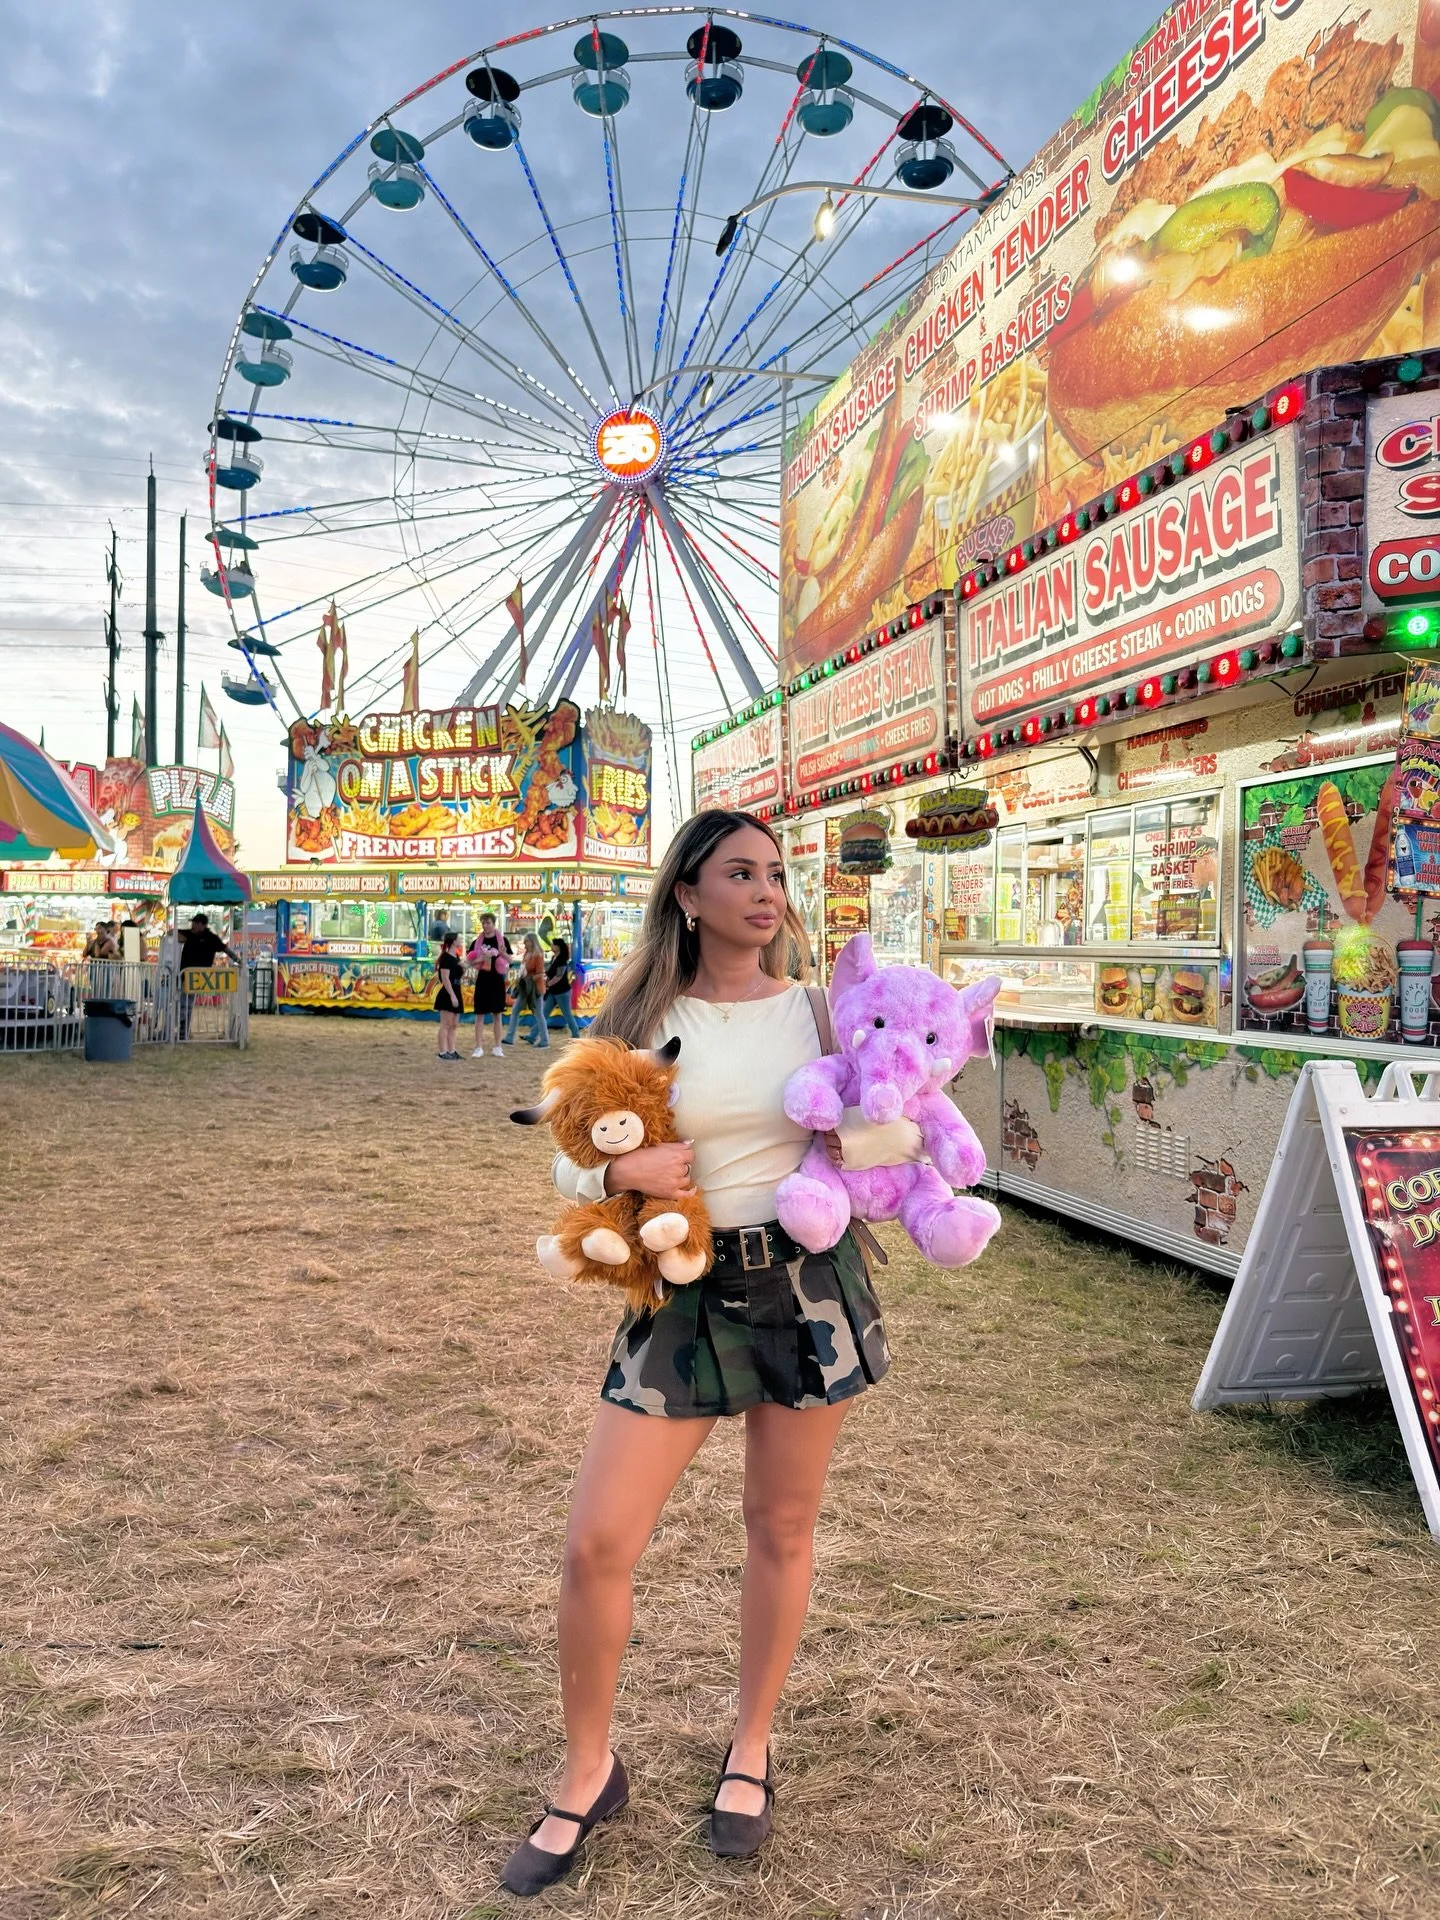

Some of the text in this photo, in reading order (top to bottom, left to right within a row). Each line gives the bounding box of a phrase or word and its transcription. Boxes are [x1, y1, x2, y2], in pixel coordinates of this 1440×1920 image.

[1101, 0, 1262, 179] CHEESE
[903, 155, 1090, 378] CHICKEN TENDER
[979, 316, 987, 340] &
[914, 273, 1071, 440] SHRIMP BASKETS
[787, 353, 896, 499] ITALIAN SAUSAGE
[956, 516, 1015, 571] BUCKET
[967, 446, 1279, 668] ITALIAN SAUSAGE
[978, 581, 1265, 713] HOT DOGS PHILLY CHEESE STEAK CORN DOGS
[794, 632, 934, 747] PHILLY CHEESE STEAK
[1294, 680, 1366, 717] CHICKEN
[1361, 702, 1376, 726] &
[359, 706, 500, 753] CHICKEN
[800, 758, 816, 778] POLISH
[817, 750, 839, 773] SAUSAGE
[885, 727, 909, 748] CHEESE
[910, 715, 931, 737] FRIES
[1160, 743, 1169, 762] &
[339, 752, 517, 798] ON A STICK
[150, 769, 234, 823] PIZZA
[591, 764, 648, 810] FRIES
[920, 788, 987, 811] ALL BEEF
[918, 831, 989, 852] HOT DOGS
[1145, 831, 1176, 842] CHEEE
[1281, 825, 1310, 835] SHRIMP
[1281, 835, 1310, 845] BASKET
[341, 827, 515, 858] FRENCH FRIES
[584, 836, 616, 861] CHICKEN
[1152, 841, 1197, 857] SHRIMP
[953, 864, 984, 877] CHICKEN
[1150, 860, 1197, 877] BASKET
[202, 878, 223, 890] EXIT
[260, 876, 291, 891] CHICKEN
[292, 876, 327, 891] TENDERS
[332, 876, 360, 891] RIBBON
[361, 876, 385, 891] CHIPS
[403, 875, 440, 891] CHICKEN
[442, 875, 471, 891] WINGS
[475, 875, 513, 891] FRENCH
[514, 875, 541, 891] FRIES
[557, 874, 581, 890] COLD
[581, 875, 613, 891] DRINKS
[952, 878, 984, 890] TENDERS
[1153, 880, 1193, 891] WITH FRIES
[953, 893, 982, 904] BASKET
[328, 943, 361, 955] CHICKEN
[361, 943, 371, 954] ON
[380, 943, 402, 954] STICK
[188, 971, 235, 991] EXIT
[290, 963, 340, 976] FRENCH FRIES
[361, 964, 406, 977] CHICKEN
